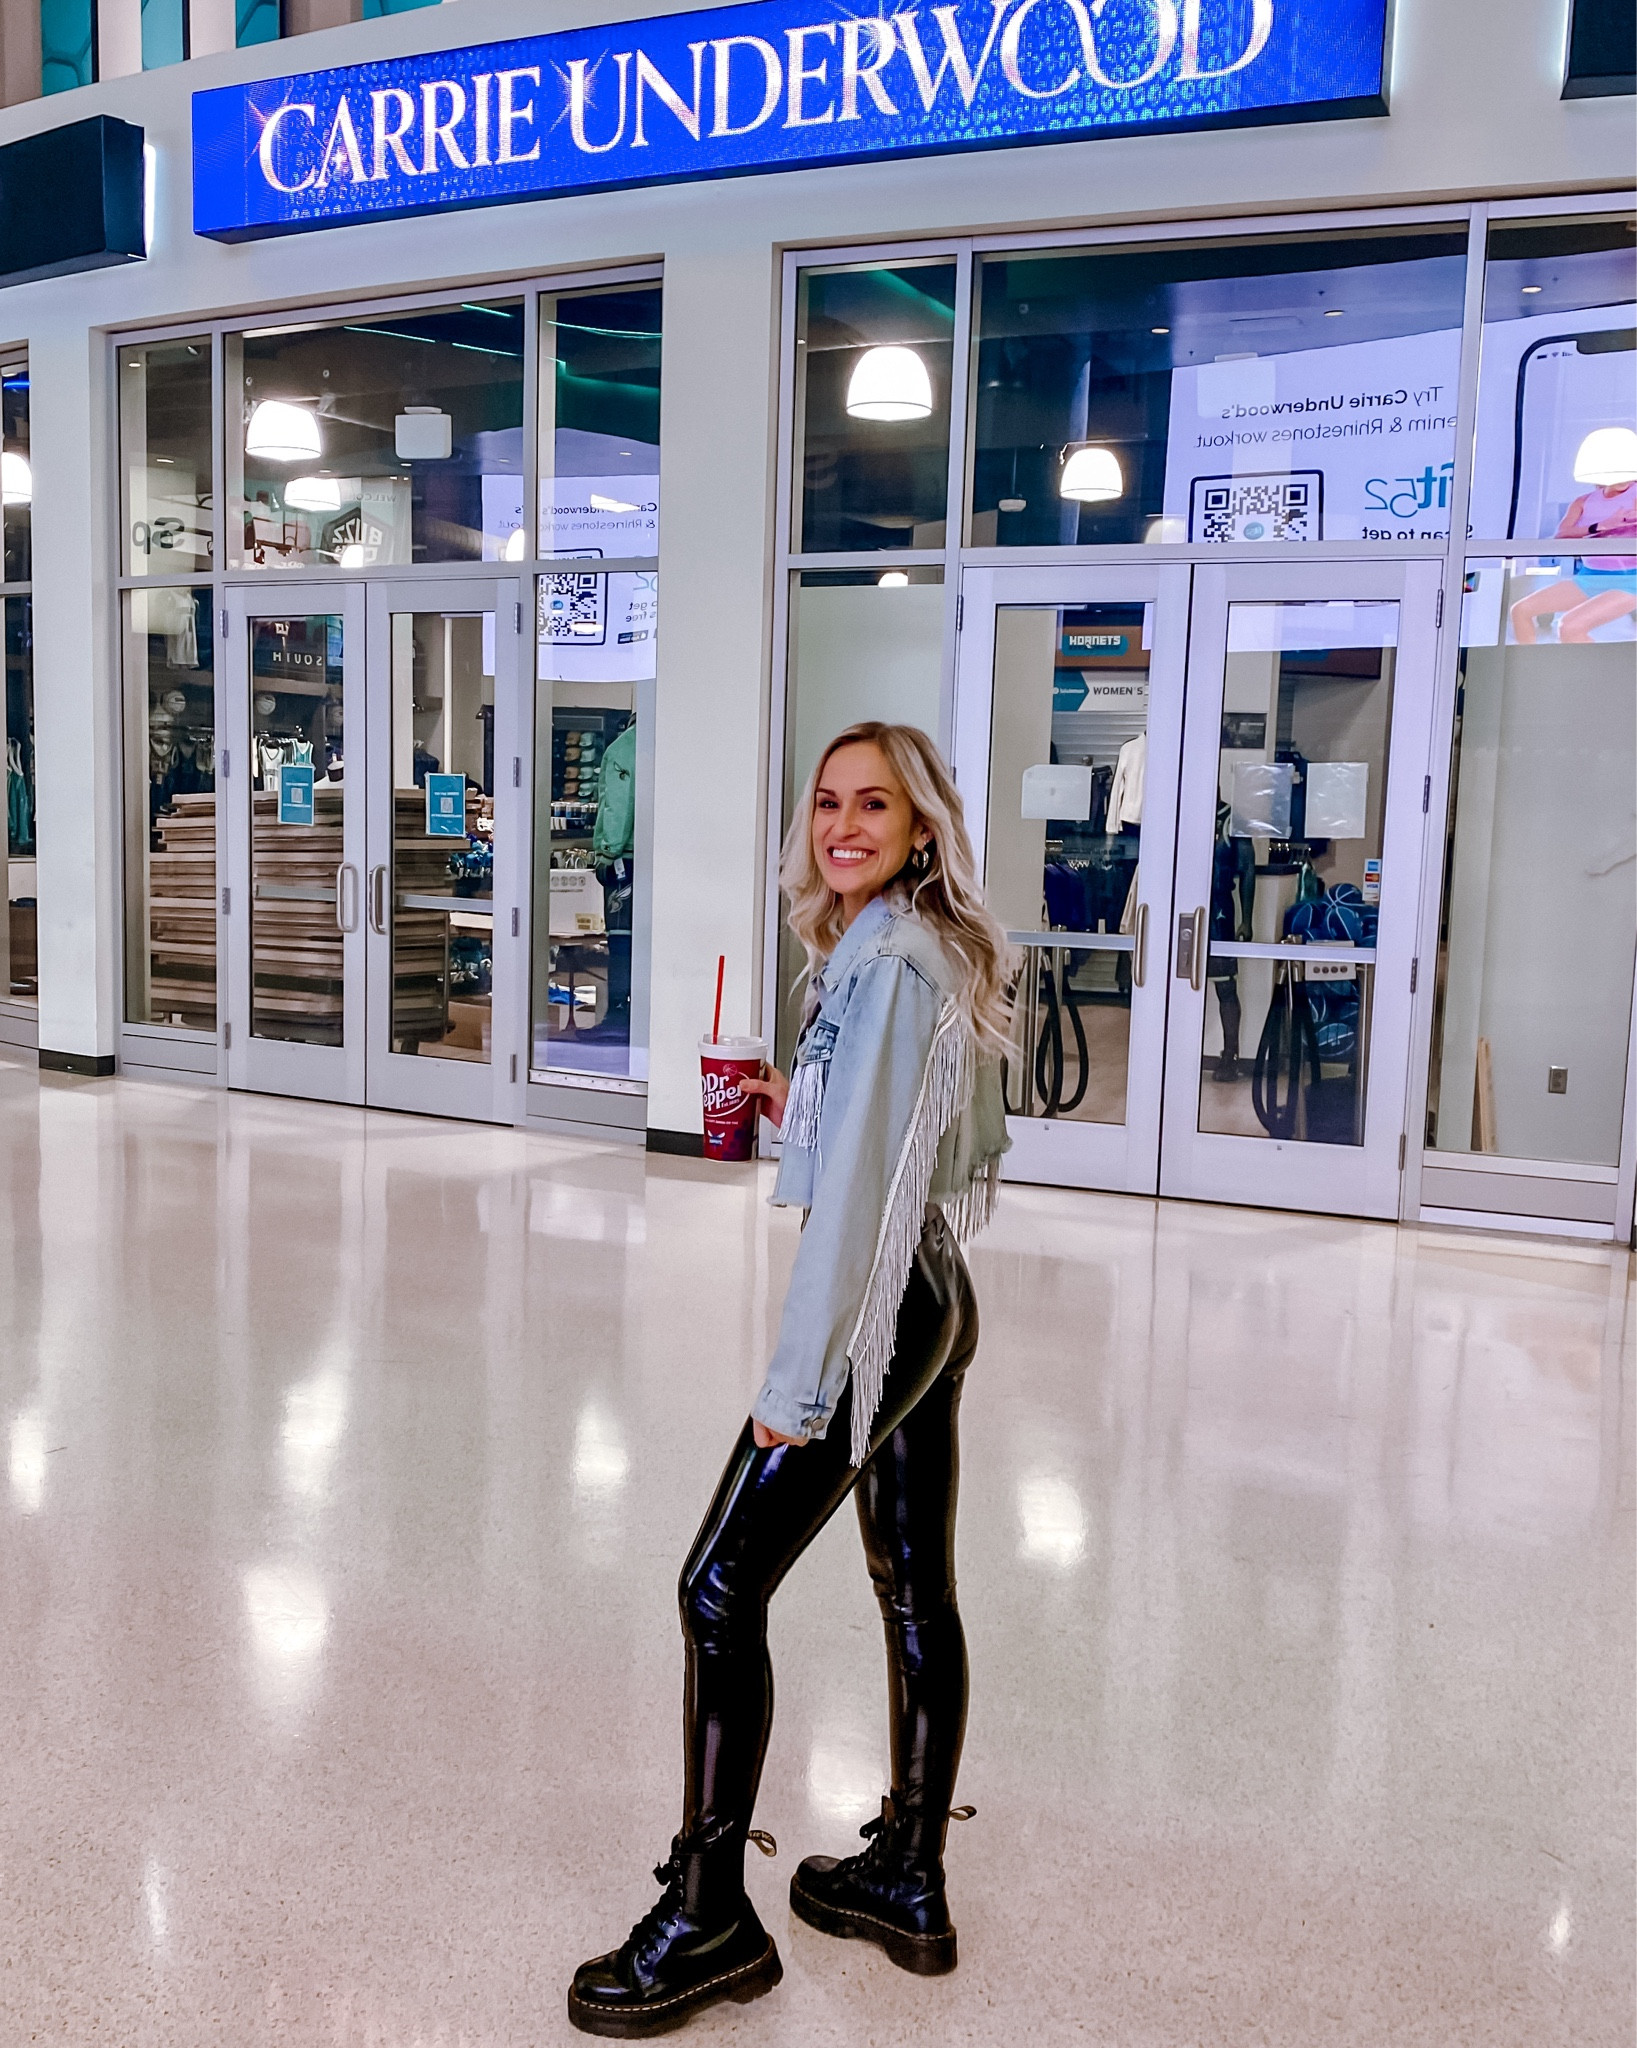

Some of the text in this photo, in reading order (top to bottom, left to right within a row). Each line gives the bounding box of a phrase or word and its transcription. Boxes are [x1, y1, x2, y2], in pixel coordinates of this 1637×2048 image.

[259, 0, 1274, 193] CARRIE UNDERWOOD
[1069, 635, 1121, 648] HORNETS
[1093, 686, 1143, 695] WOMEN'S
[705, 1072, 730, 1093] Dr
